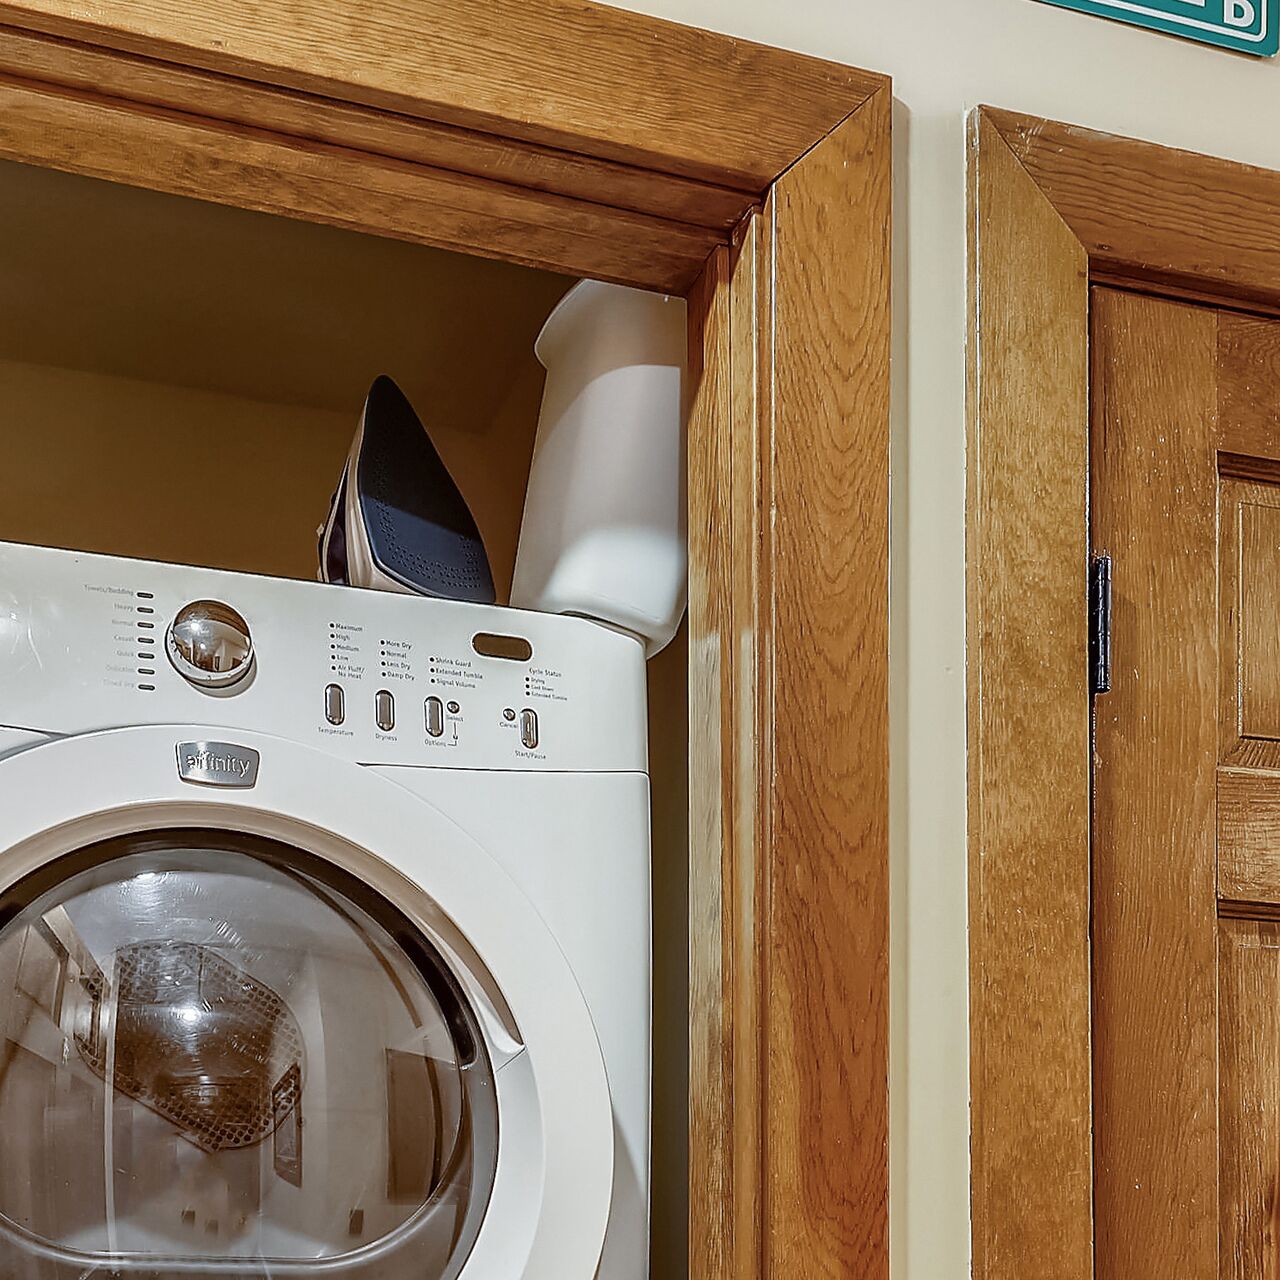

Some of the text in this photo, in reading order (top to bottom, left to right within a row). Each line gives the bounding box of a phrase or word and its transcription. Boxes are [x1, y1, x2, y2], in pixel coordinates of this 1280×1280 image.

[336, 623, 363, 632] Maximum
[336, 633, 350, 642] High
[336, 644, 359, 652] Medium
[386, 640, 412, 650] More Dry
[386, 650, 407, 659] Normal
[386, 661, 411, 671] Less Dry
[387, 671, 415, 681] Damp Dry
[318, 726, 354, 737] Temperature
[375, 732, 398, 742] Dryness
[424, 738, 447, 748] Options
[186, 750, 250, 778] affinity
